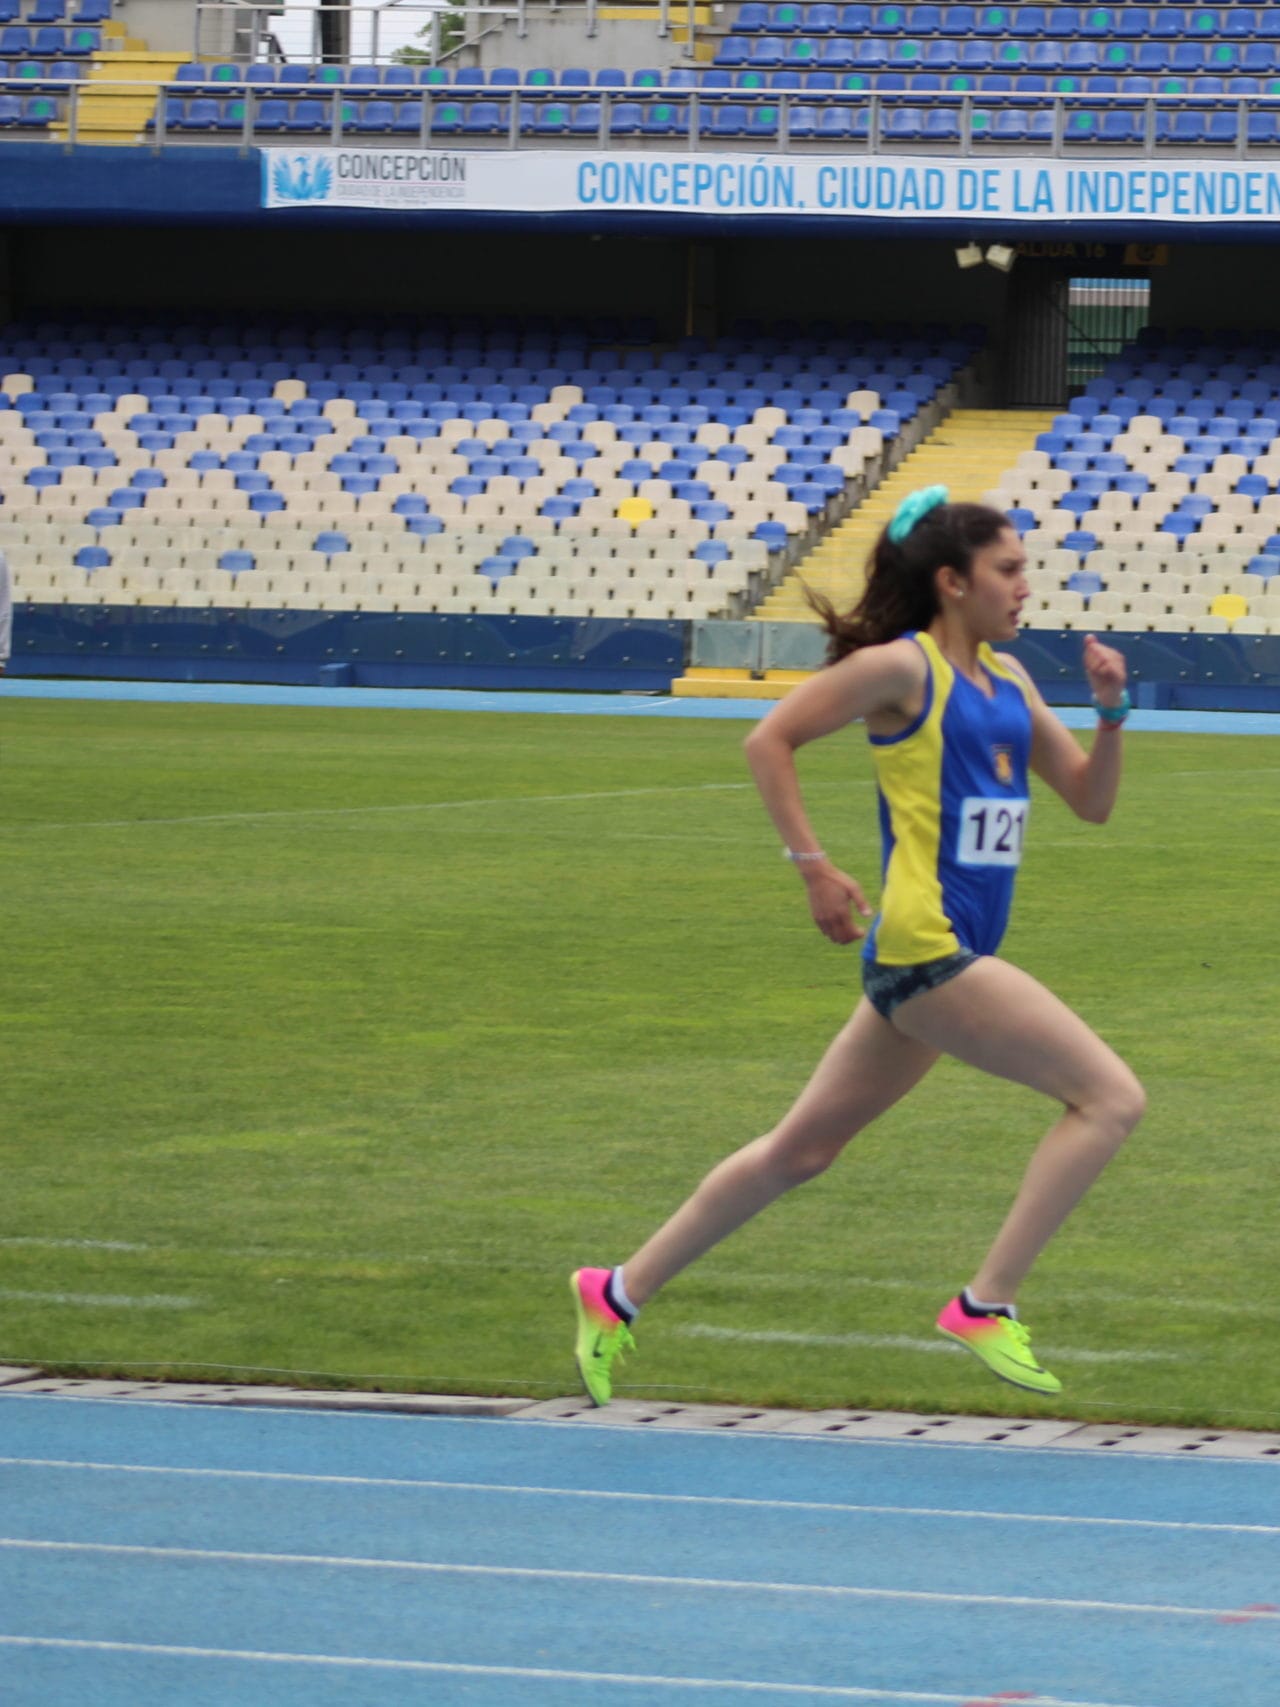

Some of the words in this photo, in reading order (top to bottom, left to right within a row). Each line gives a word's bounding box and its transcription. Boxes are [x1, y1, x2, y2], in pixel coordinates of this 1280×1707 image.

[338, 153, 466, 181] CONCEPCIÓN
[817, 166, 944, 211] CIUDAD
[956, 168, 1000, 212] DE
[1013, 169, 1054, 213] LA
[969, 808, 1024, 851] 121
